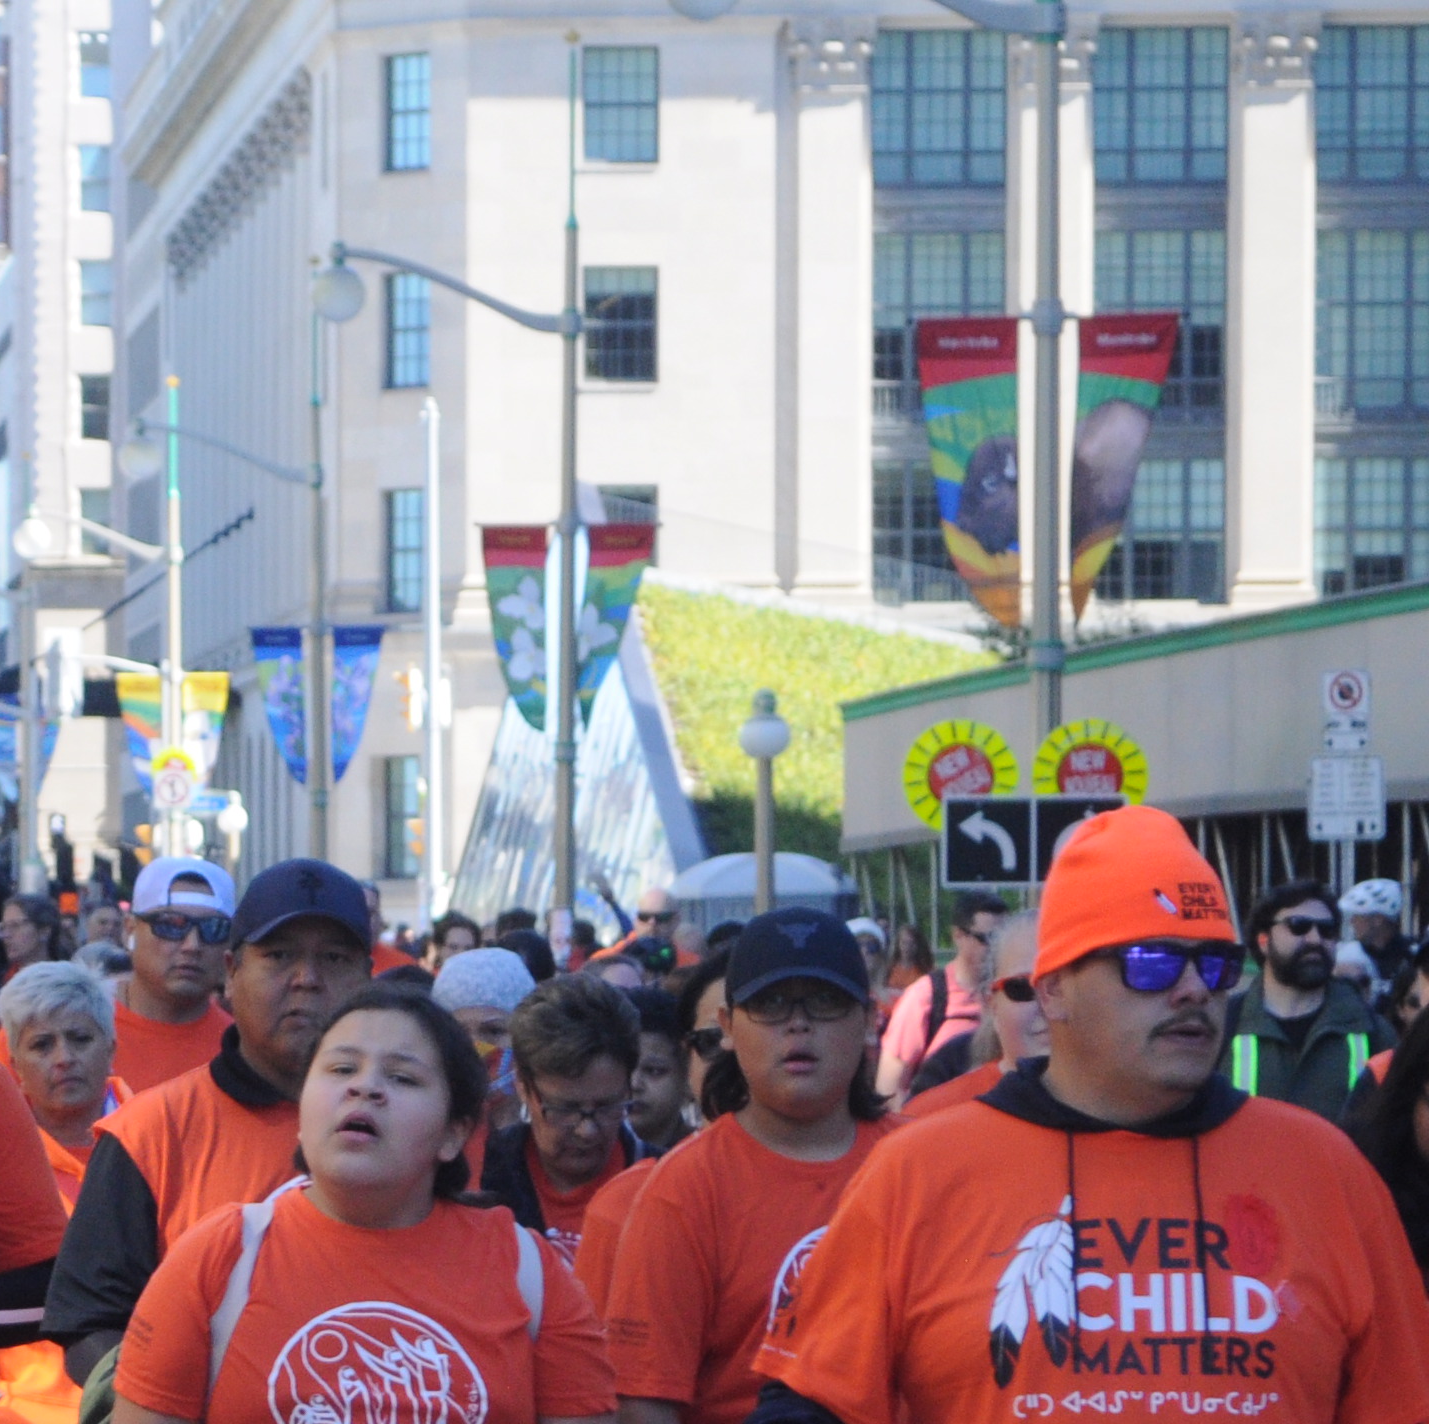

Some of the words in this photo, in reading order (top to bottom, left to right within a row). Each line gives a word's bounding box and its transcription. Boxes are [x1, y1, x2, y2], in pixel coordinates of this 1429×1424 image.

[1070, 750, 1107, 770] NEW
[1073, 1217, 1233, 1270] EVER
[1076, 1272, 1281, 1333] CHILD
[1072, 1336, 1277, 1379] MATTERS
